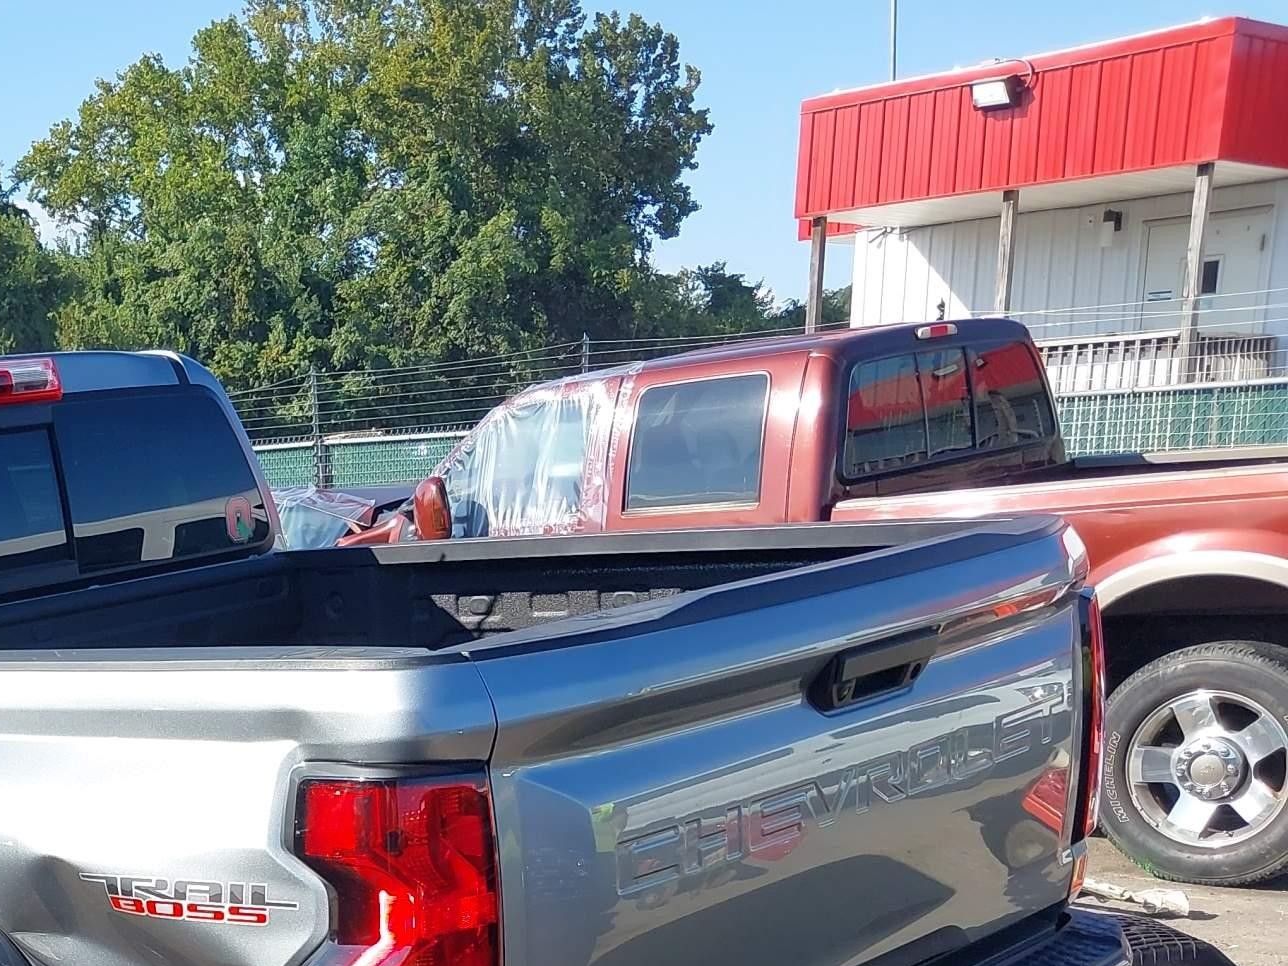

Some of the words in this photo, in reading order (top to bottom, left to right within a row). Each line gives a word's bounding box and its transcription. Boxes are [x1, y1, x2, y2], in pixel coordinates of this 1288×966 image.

[614, 688, 1073, 896] CHEVROLET
[1103, 731, 1130, 823] MICHELIN
[79, 872, 300, 910] TRAIL
[109, 895, 270, 927] BOSS
